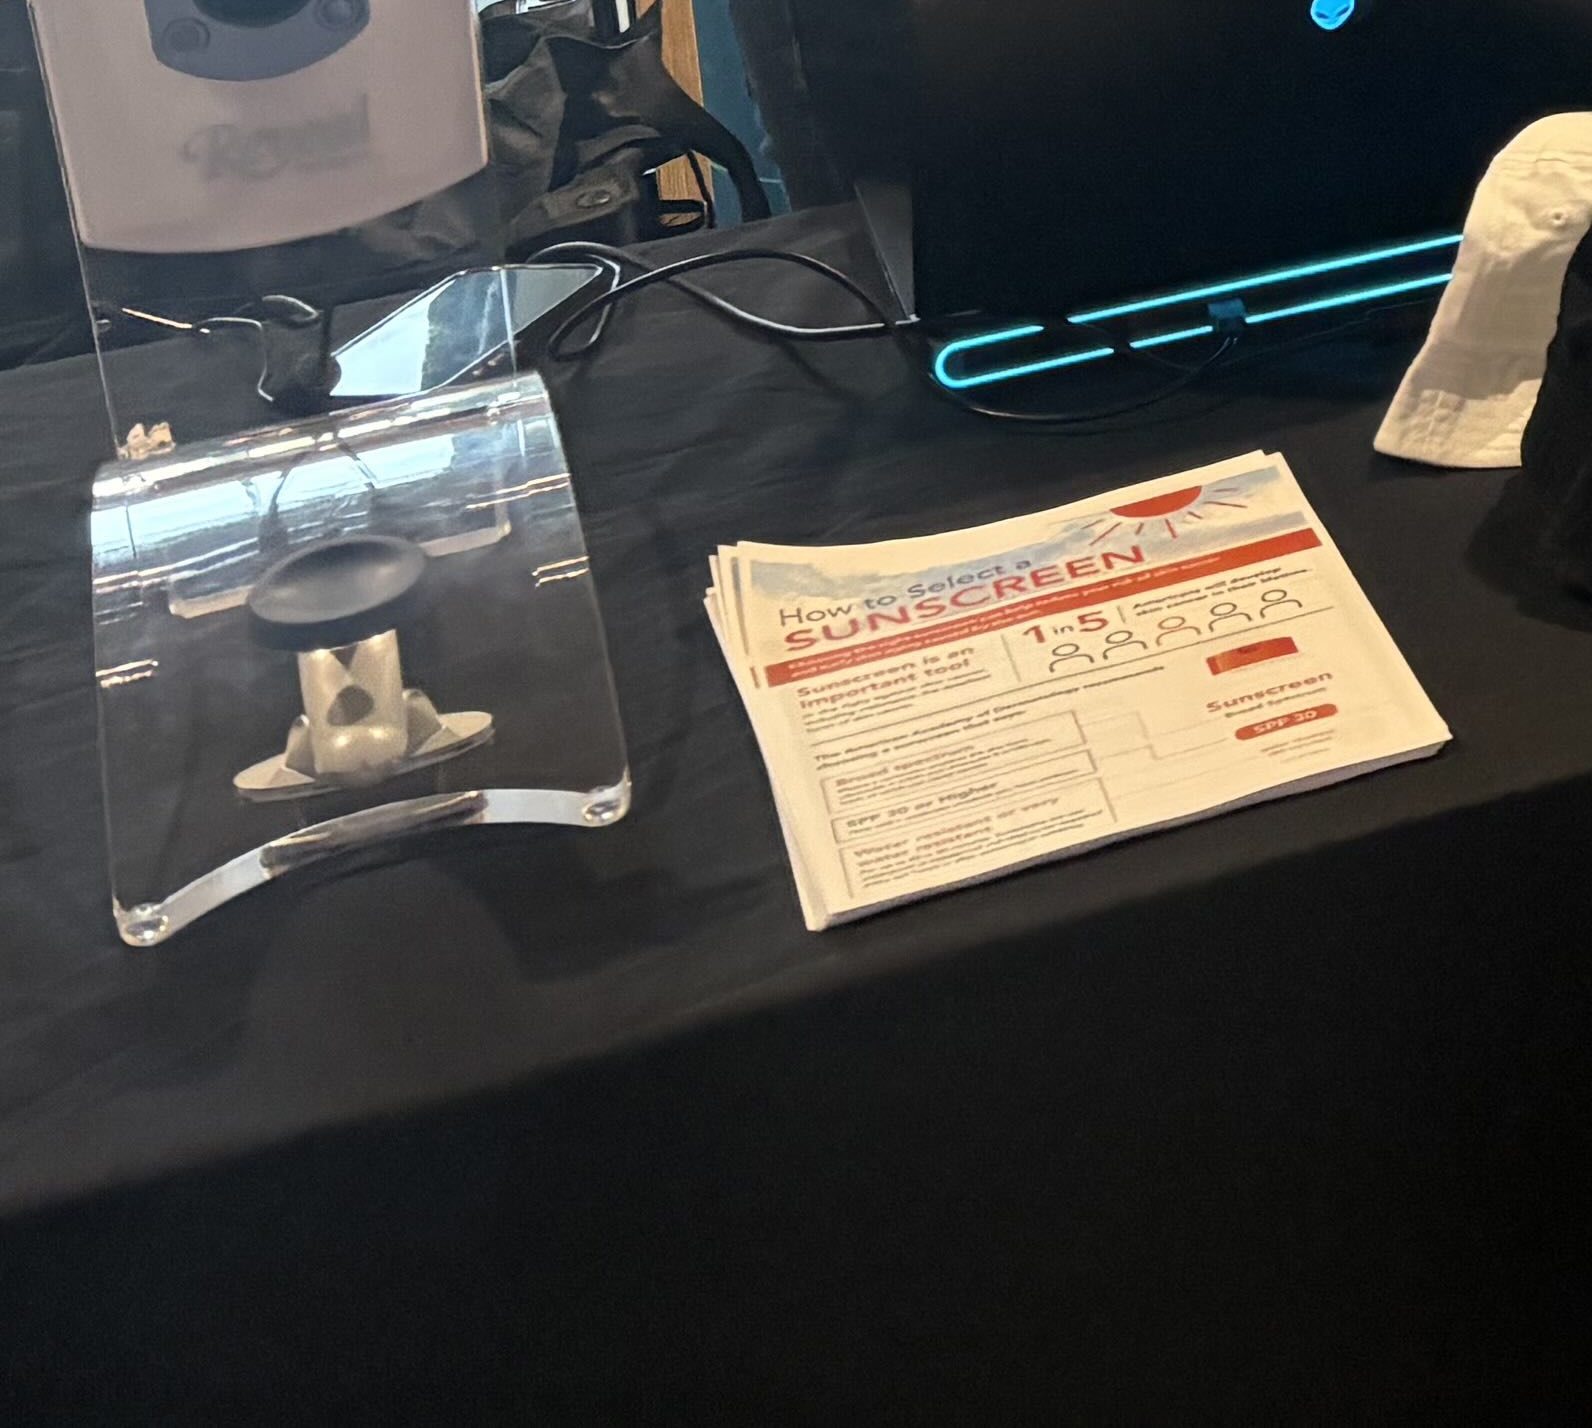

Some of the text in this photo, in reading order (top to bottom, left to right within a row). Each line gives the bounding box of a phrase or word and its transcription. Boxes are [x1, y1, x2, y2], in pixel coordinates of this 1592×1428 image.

[779, 558, 1033, 628] How to Select a
[784, 544, 1146, 653] SUNSCREEN
[1022, 609, 1110, 644] 1 in 5
[797, 660, 917, 699] Sunscreen
[922, 653, 941, 667] is
[1206, 670, 1332, 713] Sunscreen
